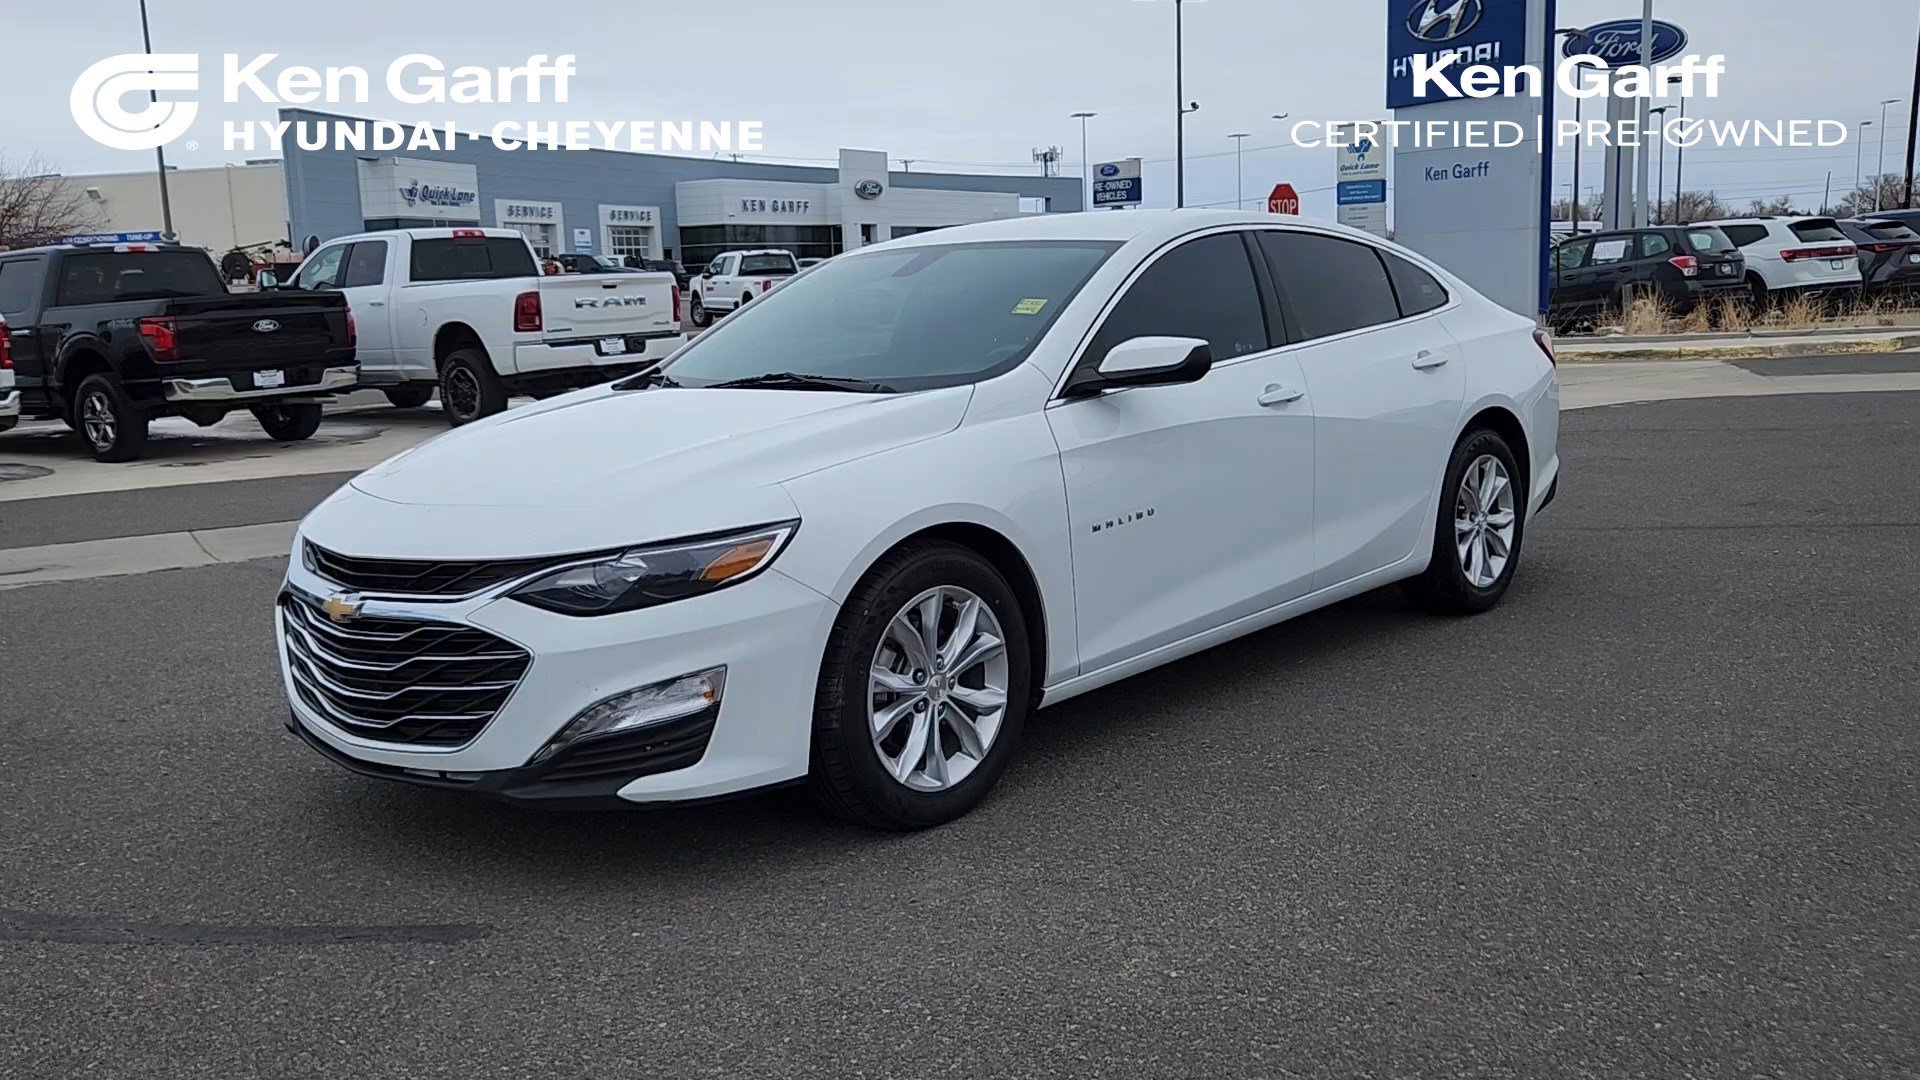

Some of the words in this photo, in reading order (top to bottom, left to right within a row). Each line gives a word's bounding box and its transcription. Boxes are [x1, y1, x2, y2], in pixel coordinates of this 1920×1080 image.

[1587, 29, 1659, 57] Ford
[1340, 164, 1359, 172] Quick
[1425, 166, 1448, 181] Ken
[1452, 161, 1490, 179] Garff
[421, 185, 450, 202] Quick
[451, 187, 476, 203] Lane
[1096, 190, 1127, 201] VEHICLES
[507, 205, 553, 218] SERVICE
[742, 199, 765, 212] KEN
[772, 200, 809, 213] GARFF
[1270, 199, 1297, 214] STOP
[610, 209, 652, 222] SERVICE
[575, 297, 647, 309] RAM
[1091, 507, 1155, 533] MALIBU
